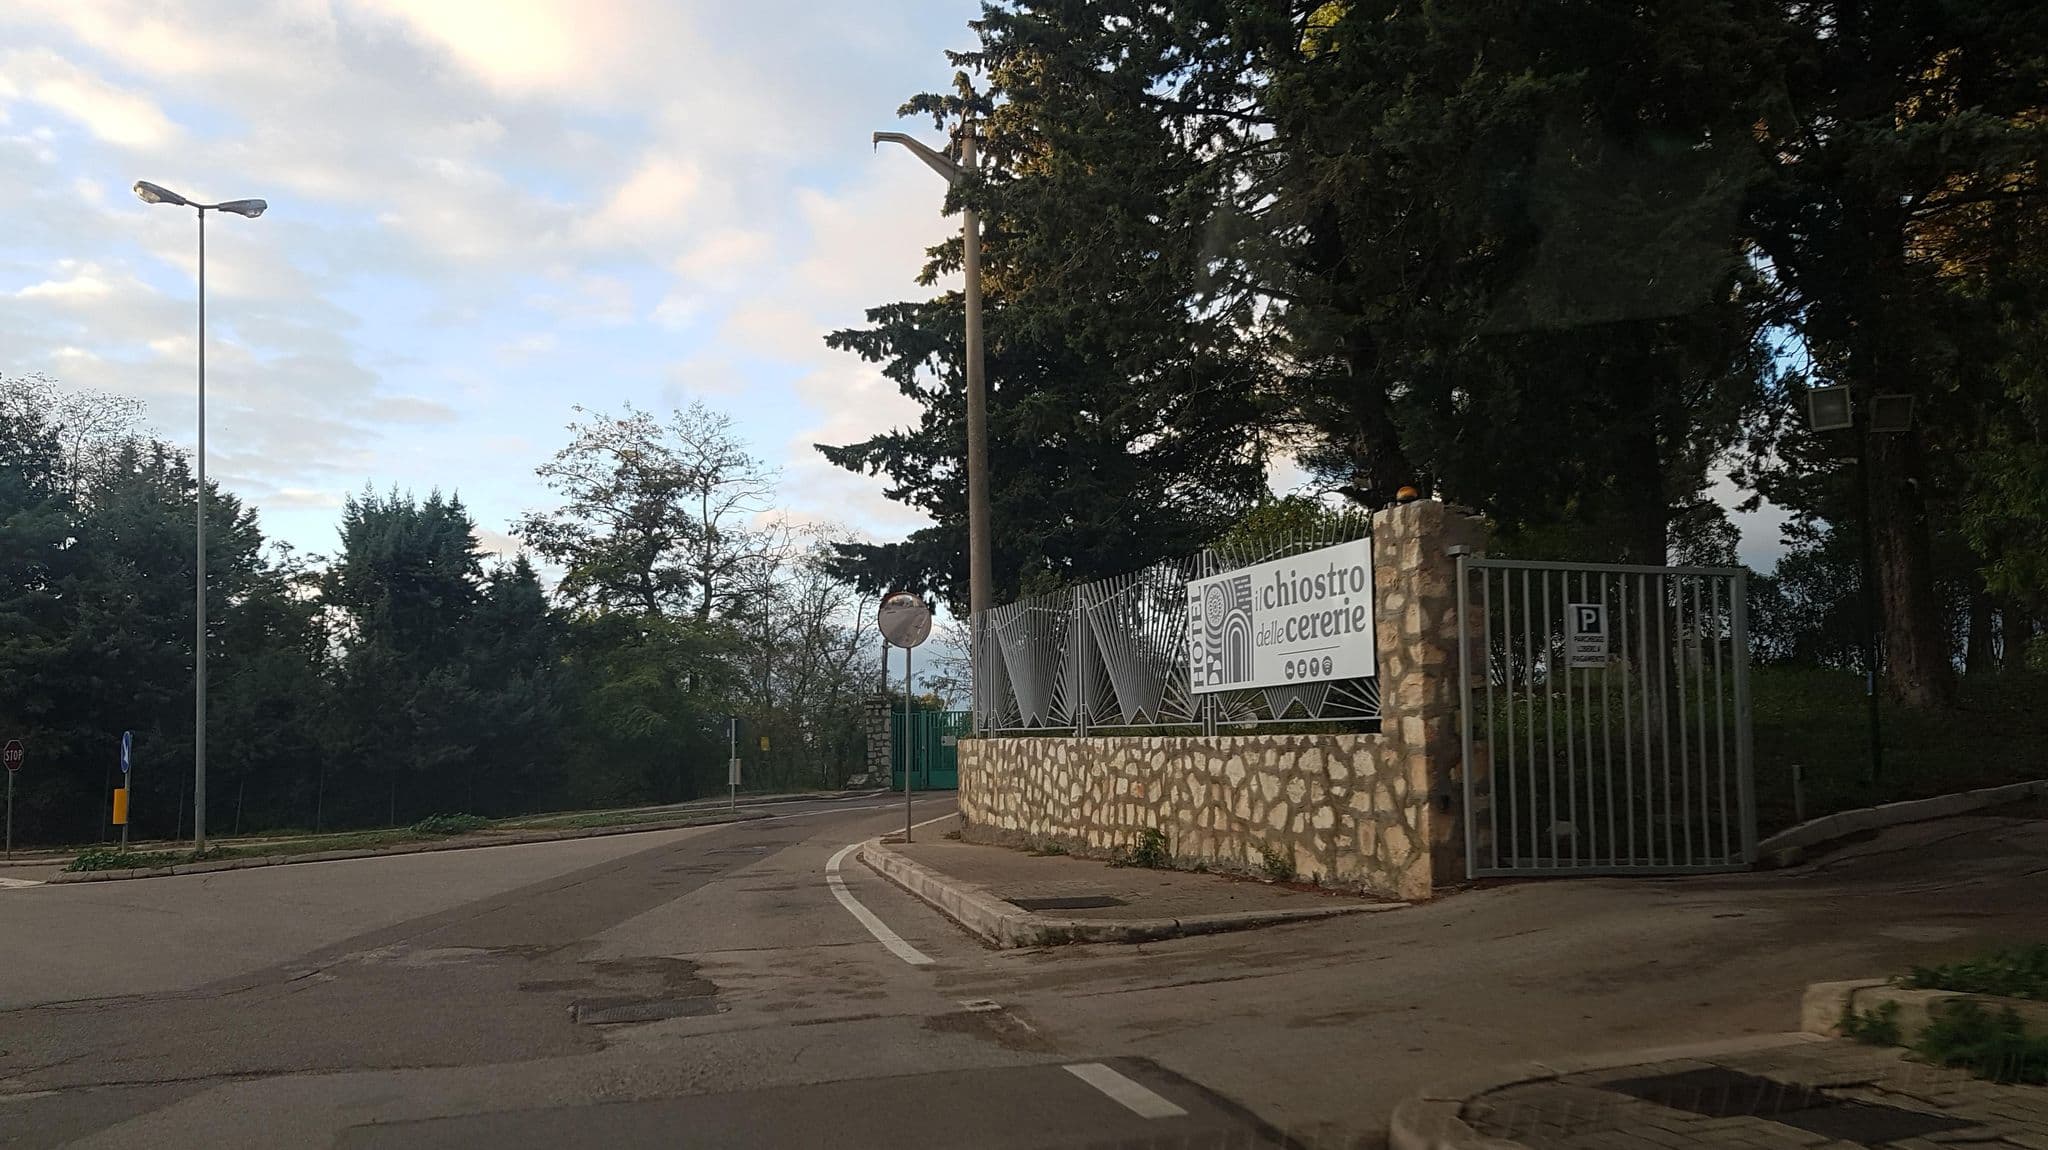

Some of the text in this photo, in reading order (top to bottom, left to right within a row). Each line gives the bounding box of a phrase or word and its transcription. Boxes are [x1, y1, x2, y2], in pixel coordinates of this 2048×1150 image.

[1255, 562, 1365, 612] il chiostro
[1191, 586, 1204, 688] HOTEL
[1256, 597, 1366, 648] delle cererie
[1581, 608, 1596, 631] P
[5, 750, 23, 762] STOP
